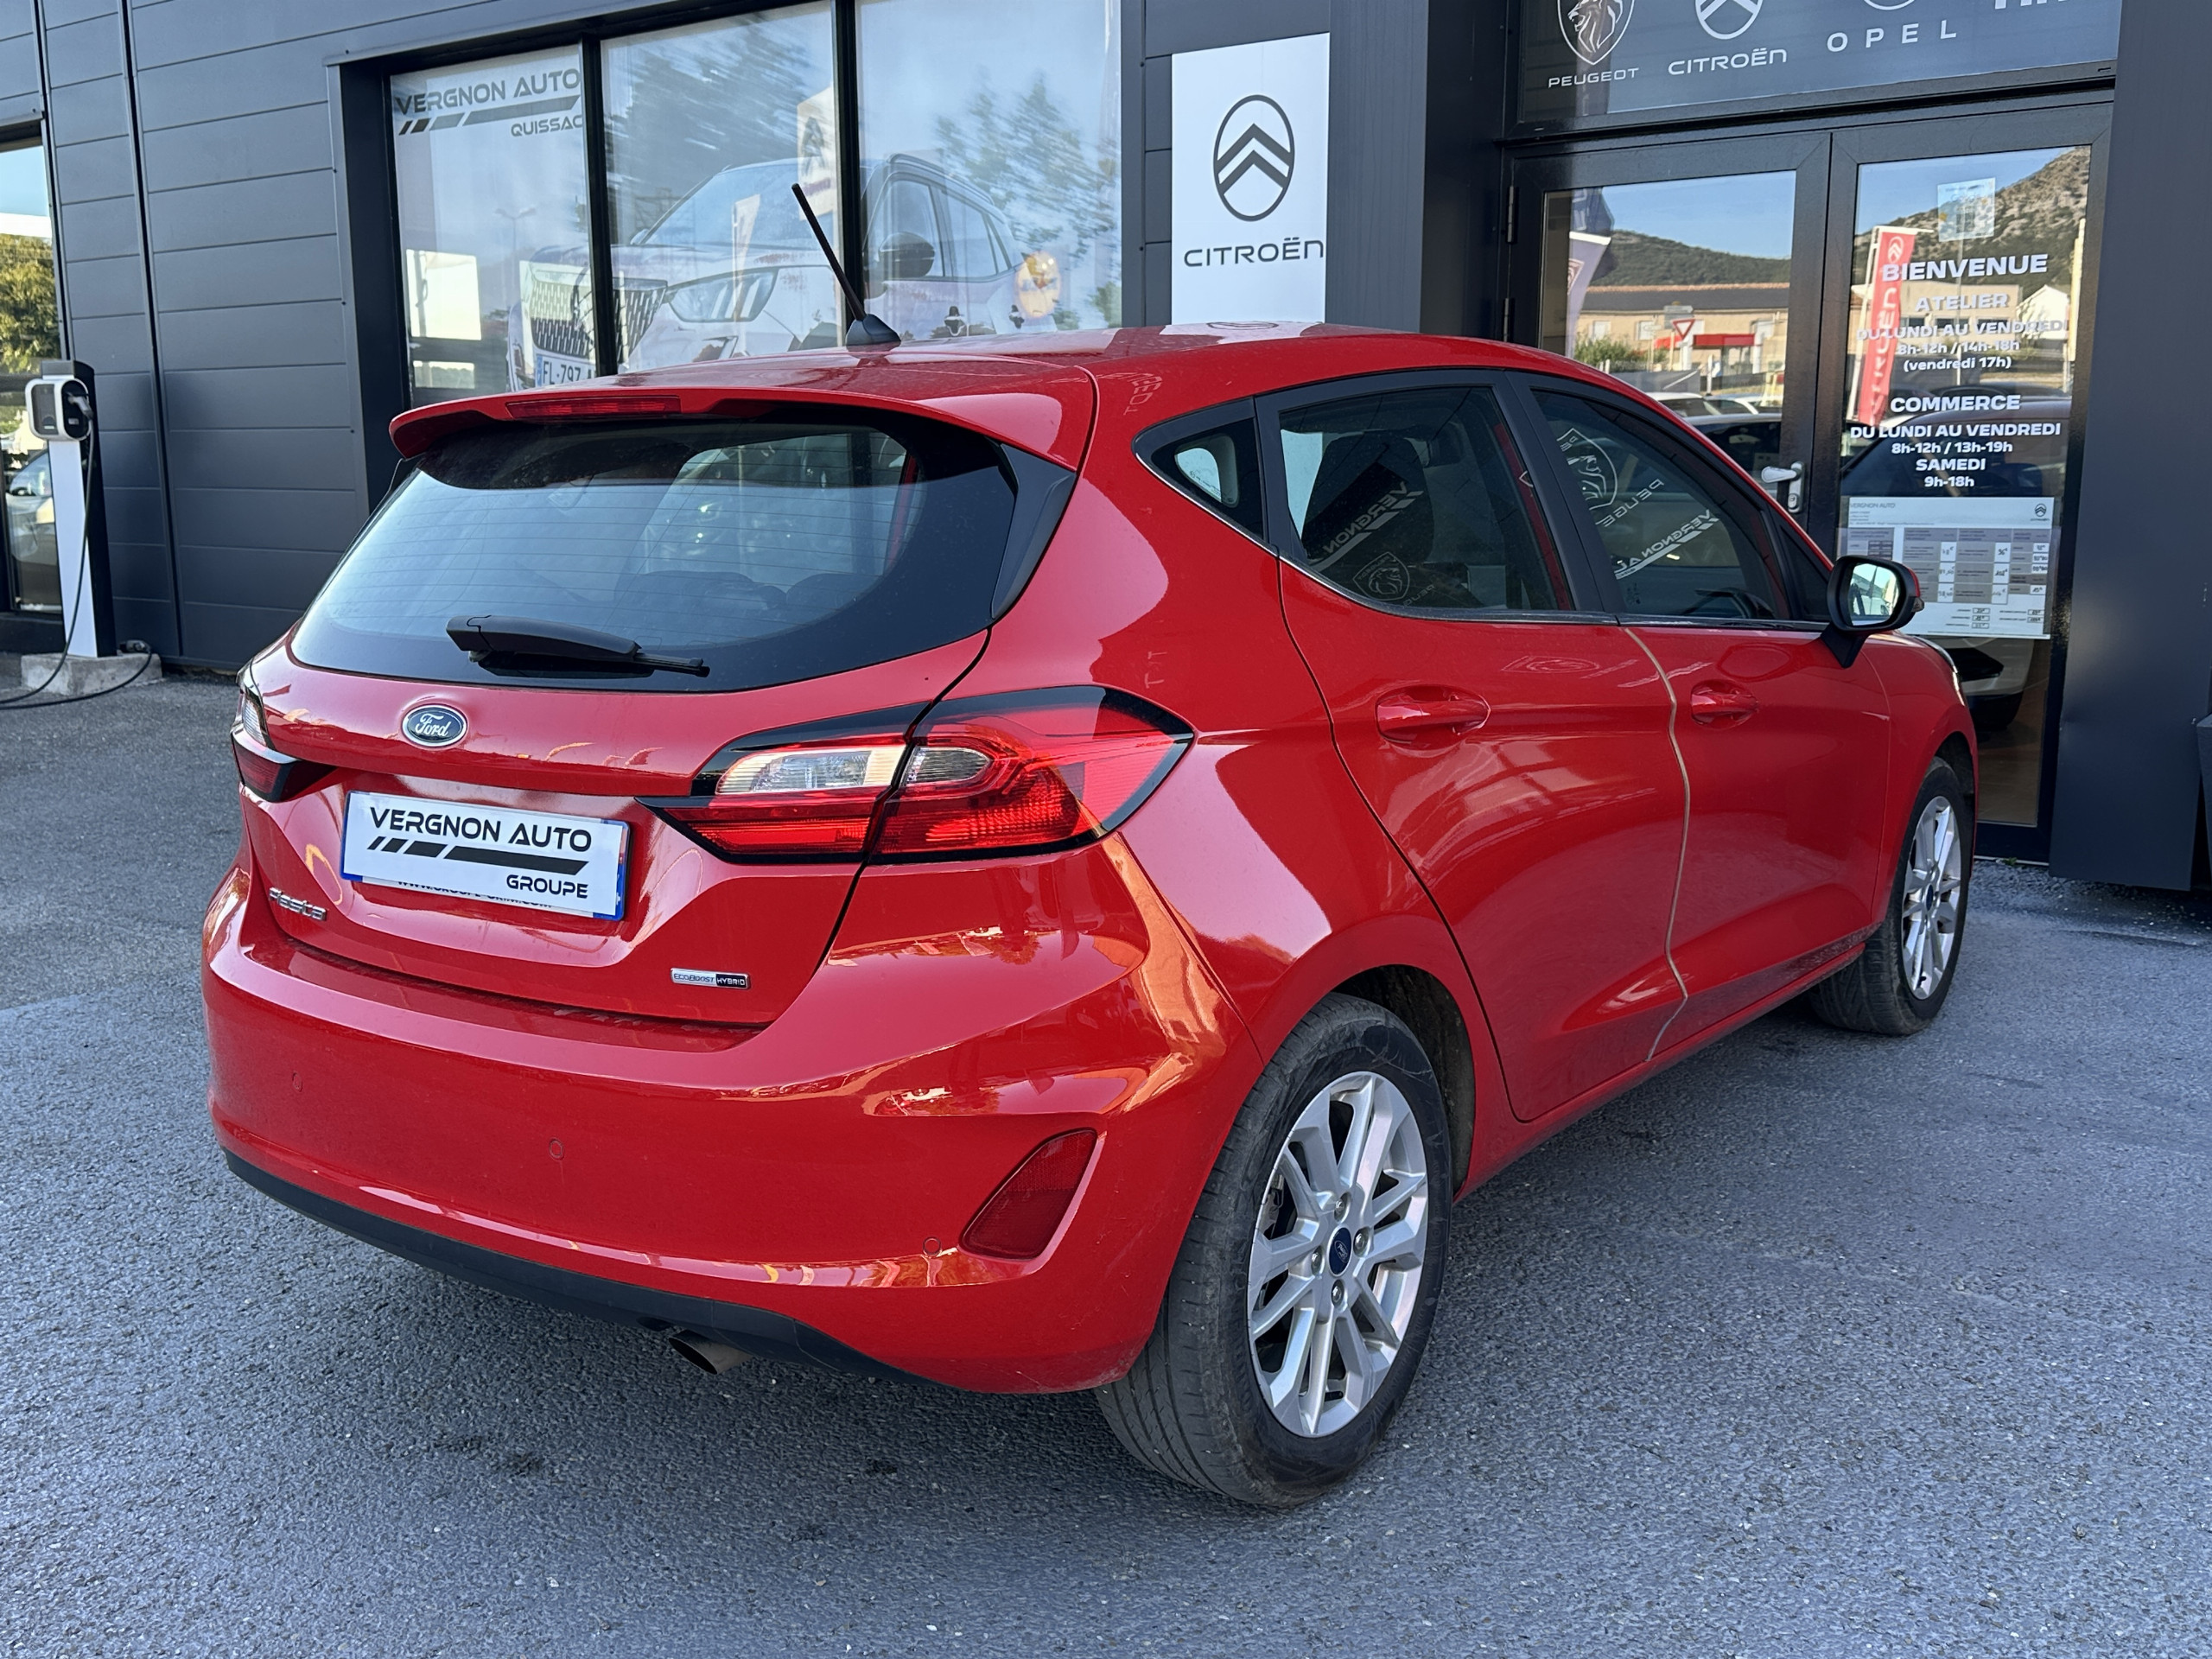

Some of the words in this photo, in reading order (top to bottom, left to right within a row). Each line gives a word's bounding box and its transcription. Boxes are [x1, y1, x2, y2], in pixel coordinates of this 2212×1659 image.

[1827, 20, 1956, 52] OPEL
[1548, 67, 1639, 88] PEUGEOT
[395, 80, 505, 115] VERGNON
[513, 68, 581, 98] AUTO
[511, 115, 583, 137] QUISSAC
[1882, 254, 2048, 282] BIENVENUE
[1915, 293, 2008, 312] ATELIER
[1856, 327, 1885, 340] DU
[1885, 325, 1937, 339] LUNDI
[1942, 323, 1967, 337] AU
[1972, 320, 2069, 335] VENDREDI
[1904, 357, 1975, 372] (vendredi
[1979, 357, 2012, 371] 17h)
[1891, 395, 2021, 412] COMMERCE
[1850, 427, 1875, 439] DU
[1878, 425, 1931, 438] LUNDI
[1935, 424, 1962, 437] AU
[1966, 423, 2061, 436] VENDREDI
[1891, 442, 1941, 454] 8h-12h
[1955, 441, 2012, 454] 13h-19h
[1916, 458, 1986, 471] SAMEDI
[1924, 475, 1974, 487] 9h-18h
[415, 713, 451, 737] Ford
[370, 807, 501, 842] VERGNON
[508, 823, 592, 852] AUTO
[506, 874, 588, 899] GROUPE
[716, 977, 746, 986] HYBRID
